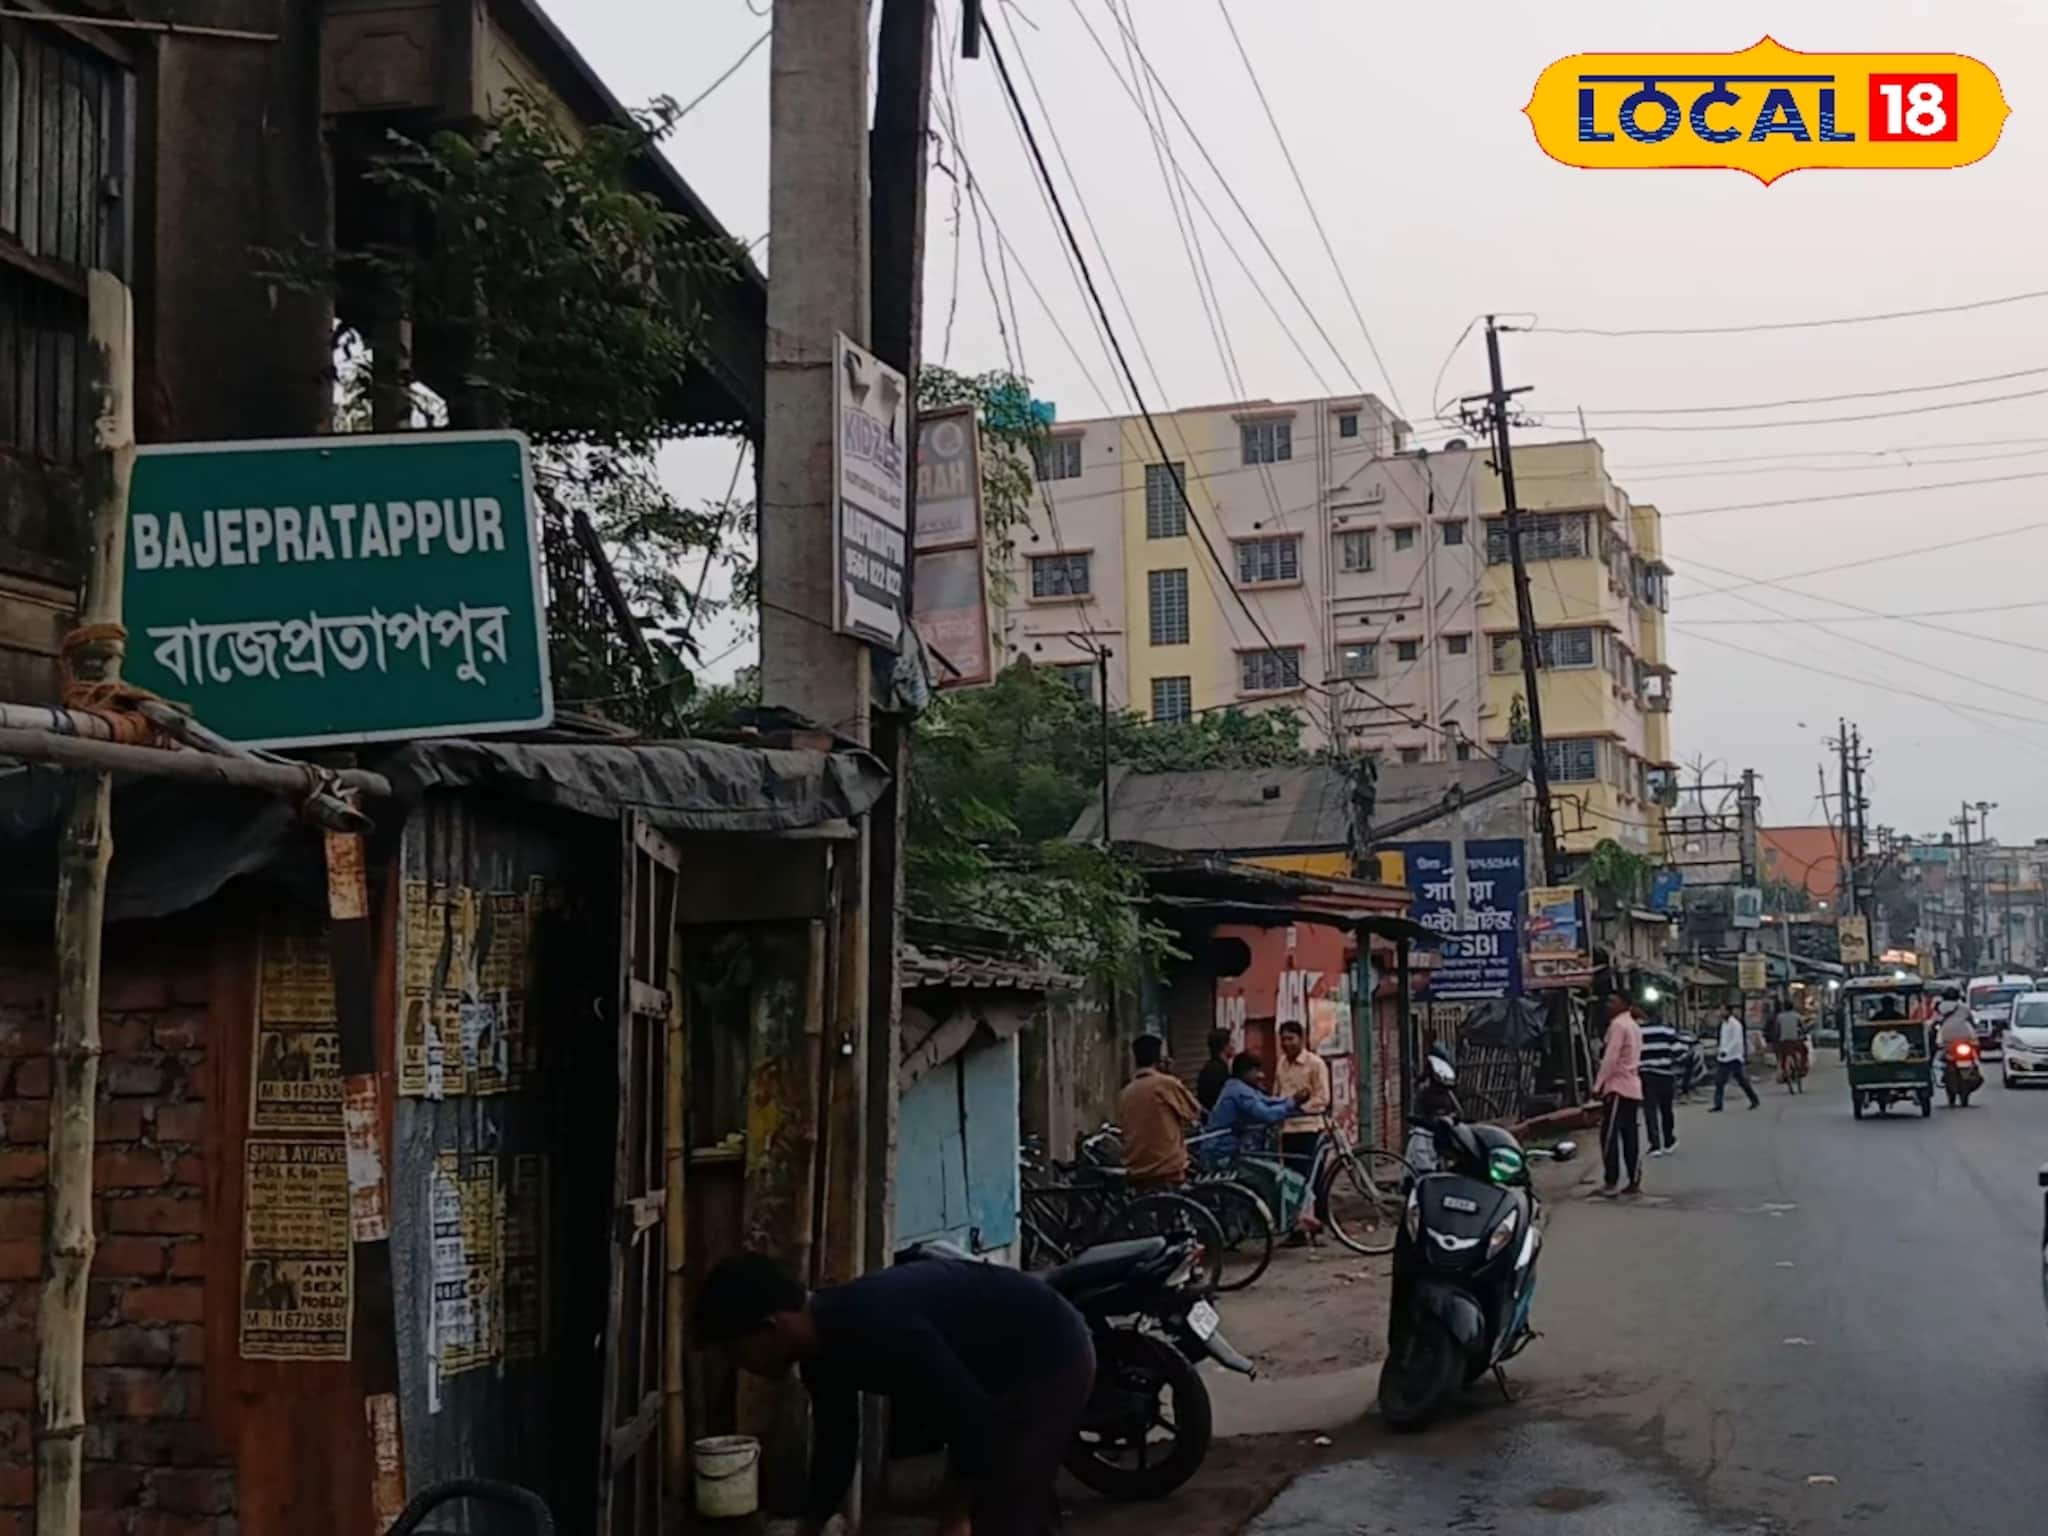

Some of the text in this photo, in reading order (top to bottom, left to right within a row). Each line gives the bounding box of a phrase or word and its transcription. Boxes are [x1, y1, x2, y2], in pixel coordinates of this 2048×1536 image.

[132, 496, 506, 571] BAJEPRATAPPUR
[147, 601, 511, 687] বাজেপ্রতাপপুর
[1460, 933, 1499, 957] SBI
[302, 1263, 346, 1277] ANY
[302, 1280, 343, 1293] SEX
